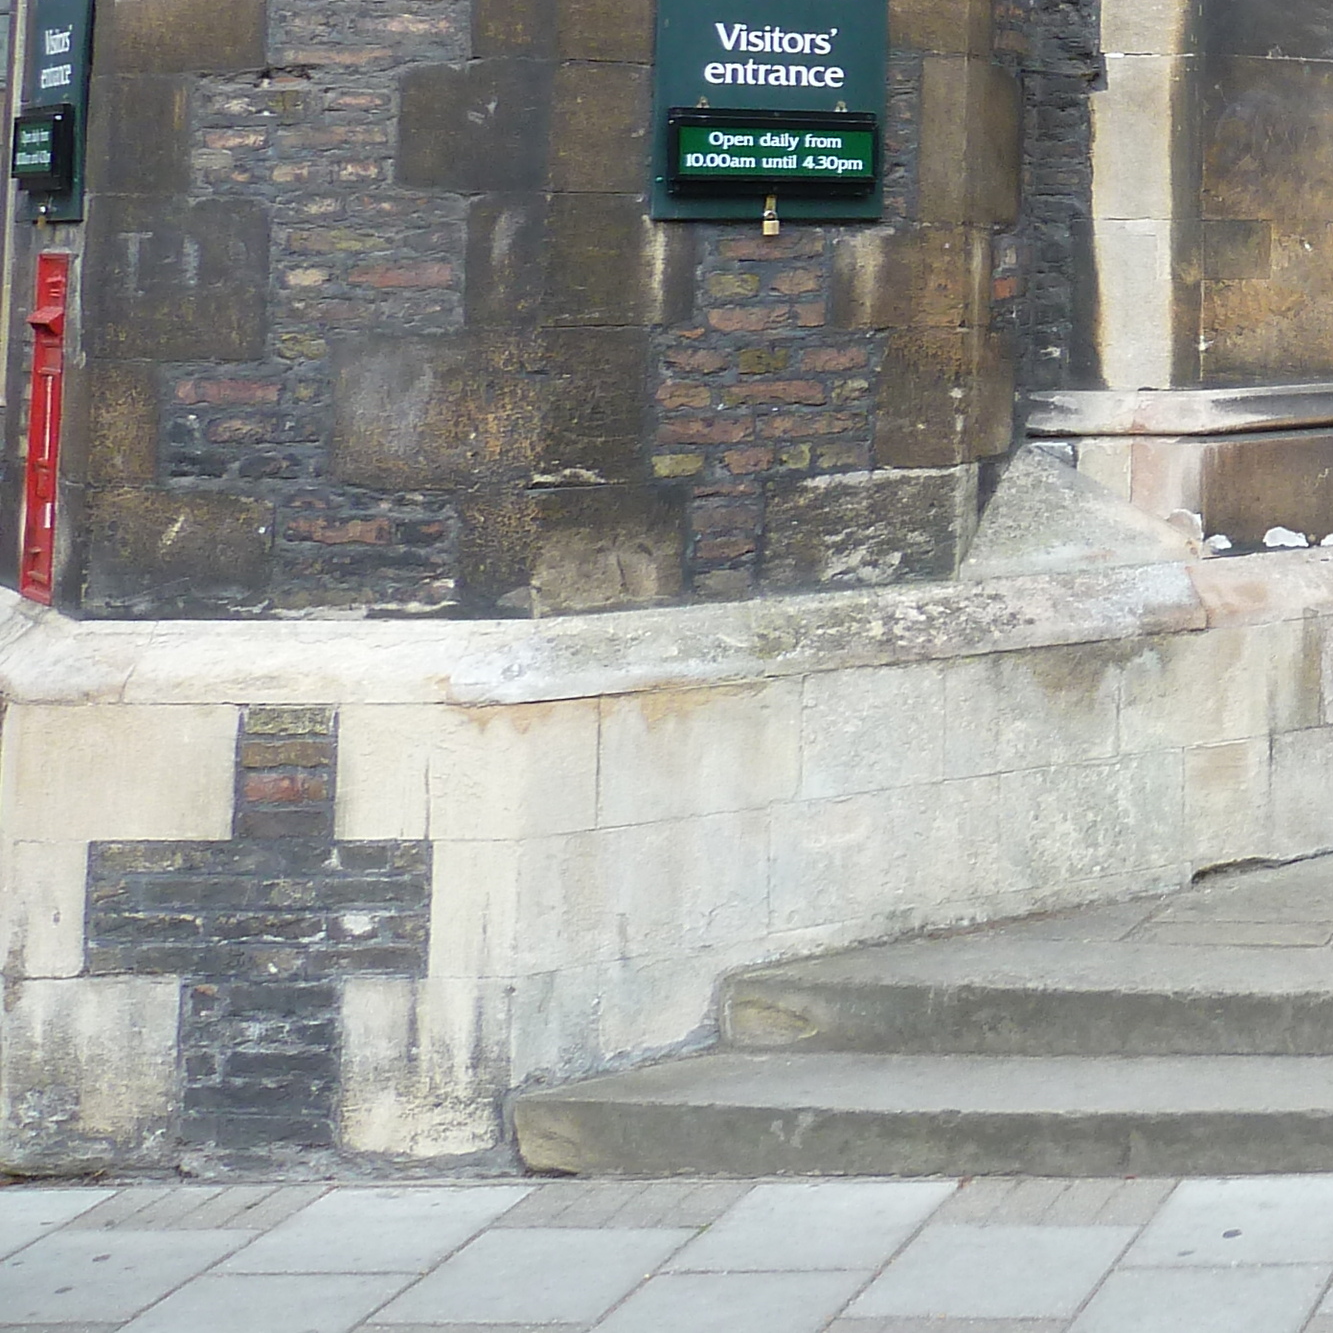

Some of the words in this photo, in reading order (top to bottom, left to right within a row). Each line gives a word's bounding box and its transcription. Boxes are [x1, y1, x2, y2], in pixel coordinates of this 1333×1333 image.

[715, 23, 838, 55] Visitors'
[704, 59, 844, 87] entrance
[709, 132, 754, 149] Open
[759, 133, 799, 151] daily
[804, 134, 842, 148] from
[686, 154, 756, 168] 10.00am
[762, 155, 797, 169] until
[802, 155, 863, 173] 4.30pm
